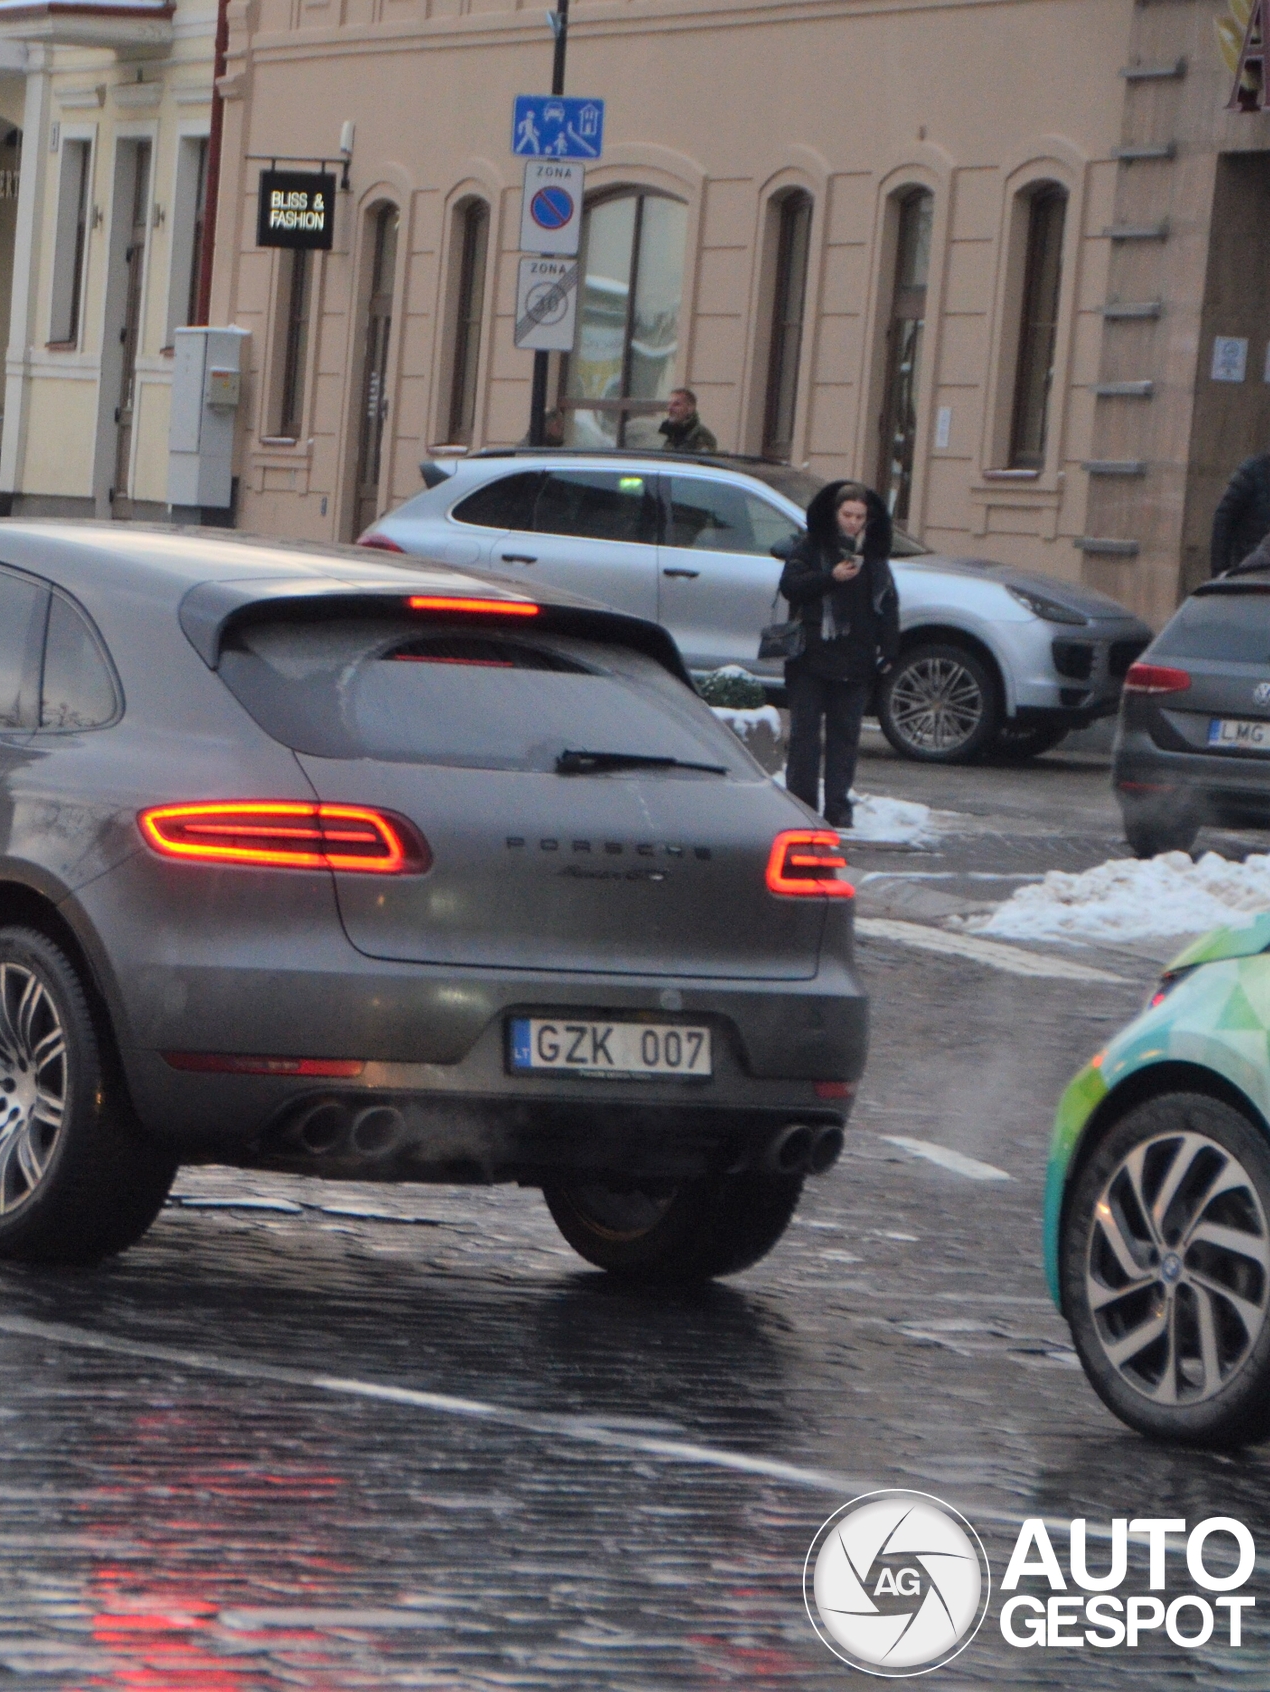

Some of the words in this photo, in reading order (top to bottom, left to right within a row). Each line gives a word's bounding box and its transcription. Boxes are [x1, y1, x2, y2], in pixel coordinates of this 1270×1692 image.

[537, 165, 572, 179] ZONA
[271, 190, 308, 211] BLISS
[313, 193, 325, 212] &
[270, 209, 325, 231] FASHION
[531, 262, 566, 275] ZONA
[1222, 722, 1263, 742] LMG
[537, 1024, 615, 1066] GZK
[640, 1029, 704, 1069] 007
